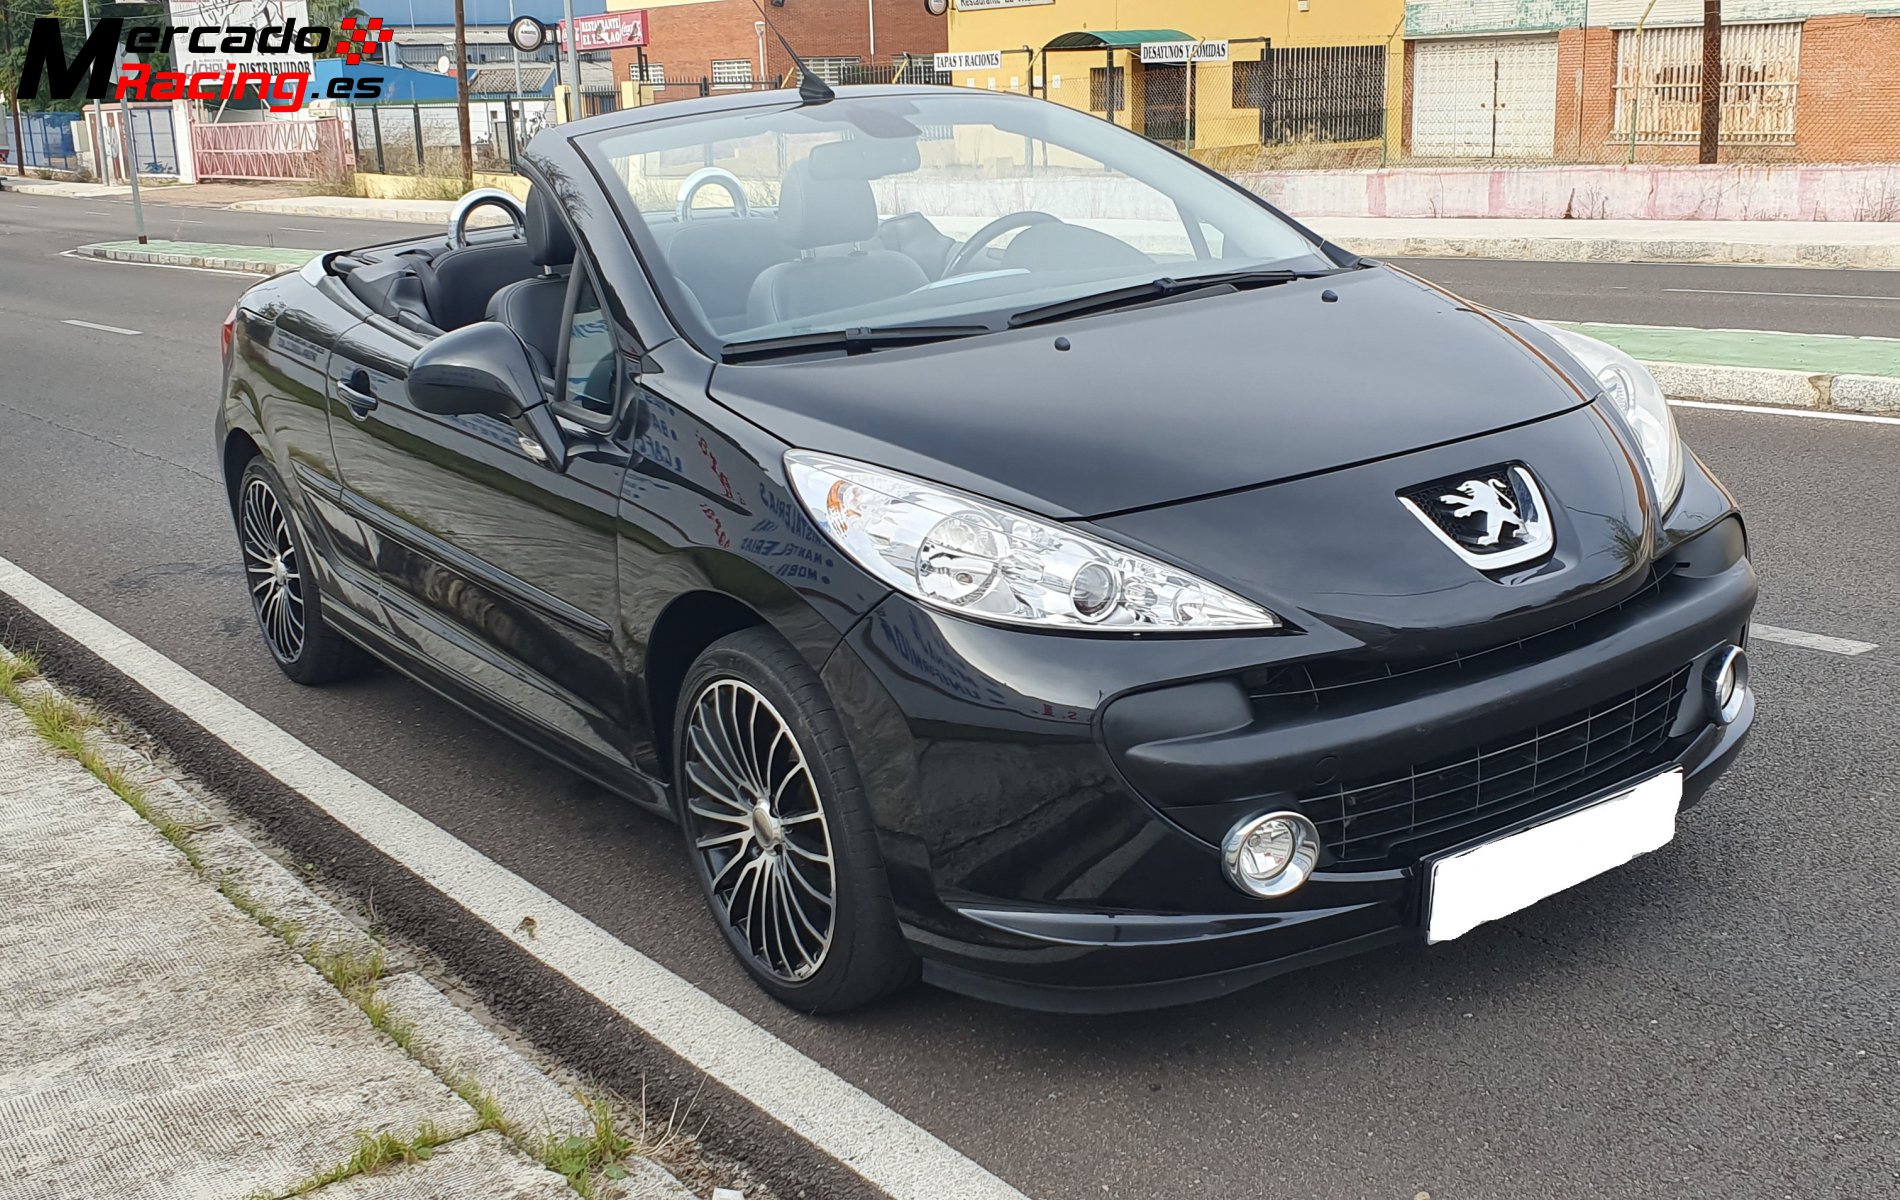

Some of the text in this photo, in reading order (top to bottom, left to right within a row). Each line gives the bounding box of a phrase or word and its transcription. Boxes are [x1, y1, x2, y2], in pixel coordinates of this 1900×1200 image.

[583, 34, 593, 45] EL
[1143, 43, 1226, 60] DESAYUNOS Y COMIDAS
[936, 53, 999, 68] TAPAS Y RACIONES
[239, 61, 312, 76] DISTRIBUIDOR
